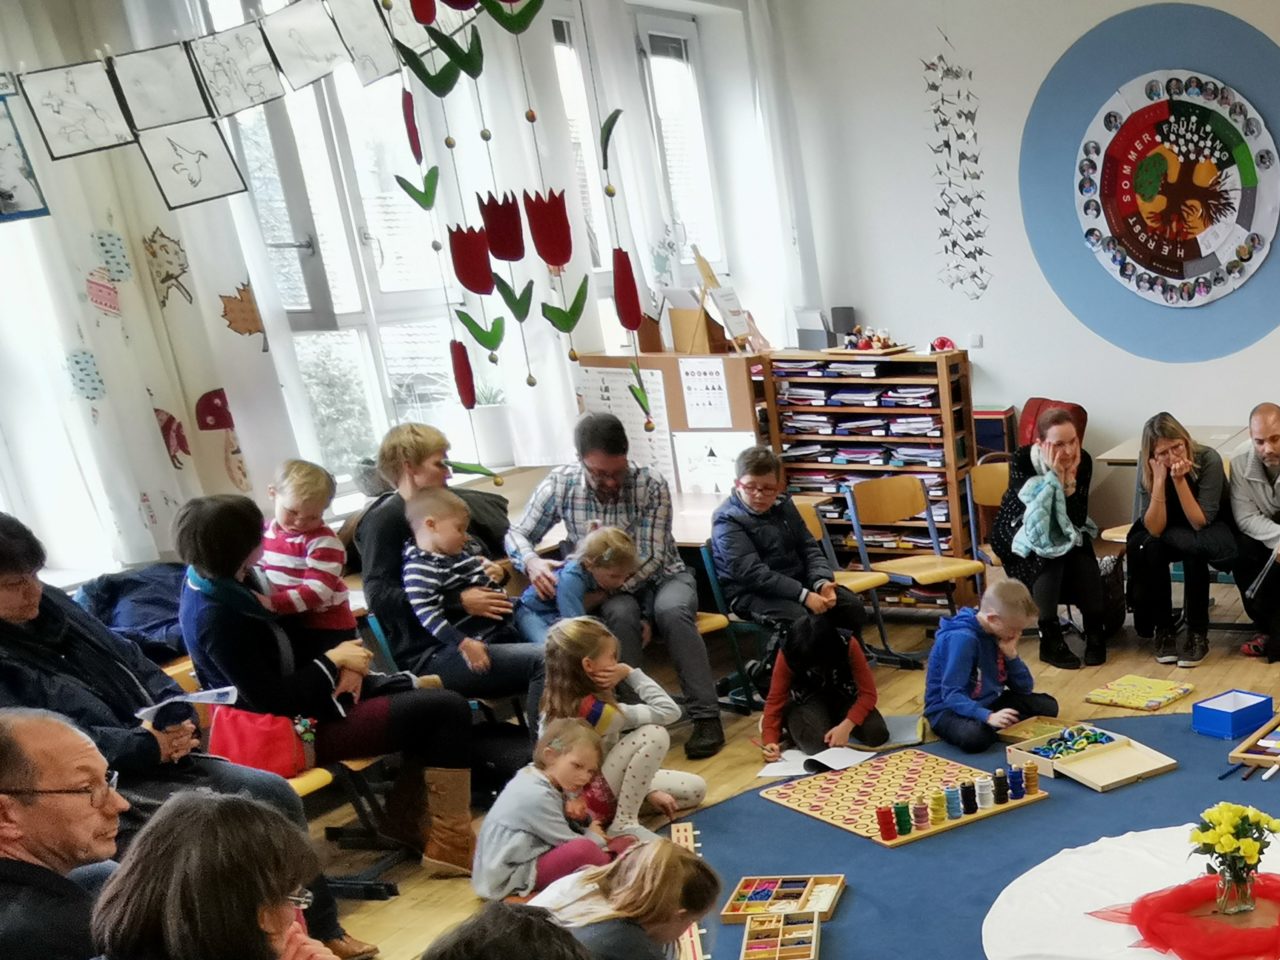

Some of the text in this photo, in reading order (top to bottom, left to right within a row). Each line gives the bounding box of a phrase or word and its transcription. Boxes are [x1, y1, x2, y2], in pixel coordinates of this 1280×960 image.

[1162, 117, 1230, 161] FRÜHLING
[1121, 133, 1152, 203] SOMMER
[1127, 216, 1185, 259] HERBST
